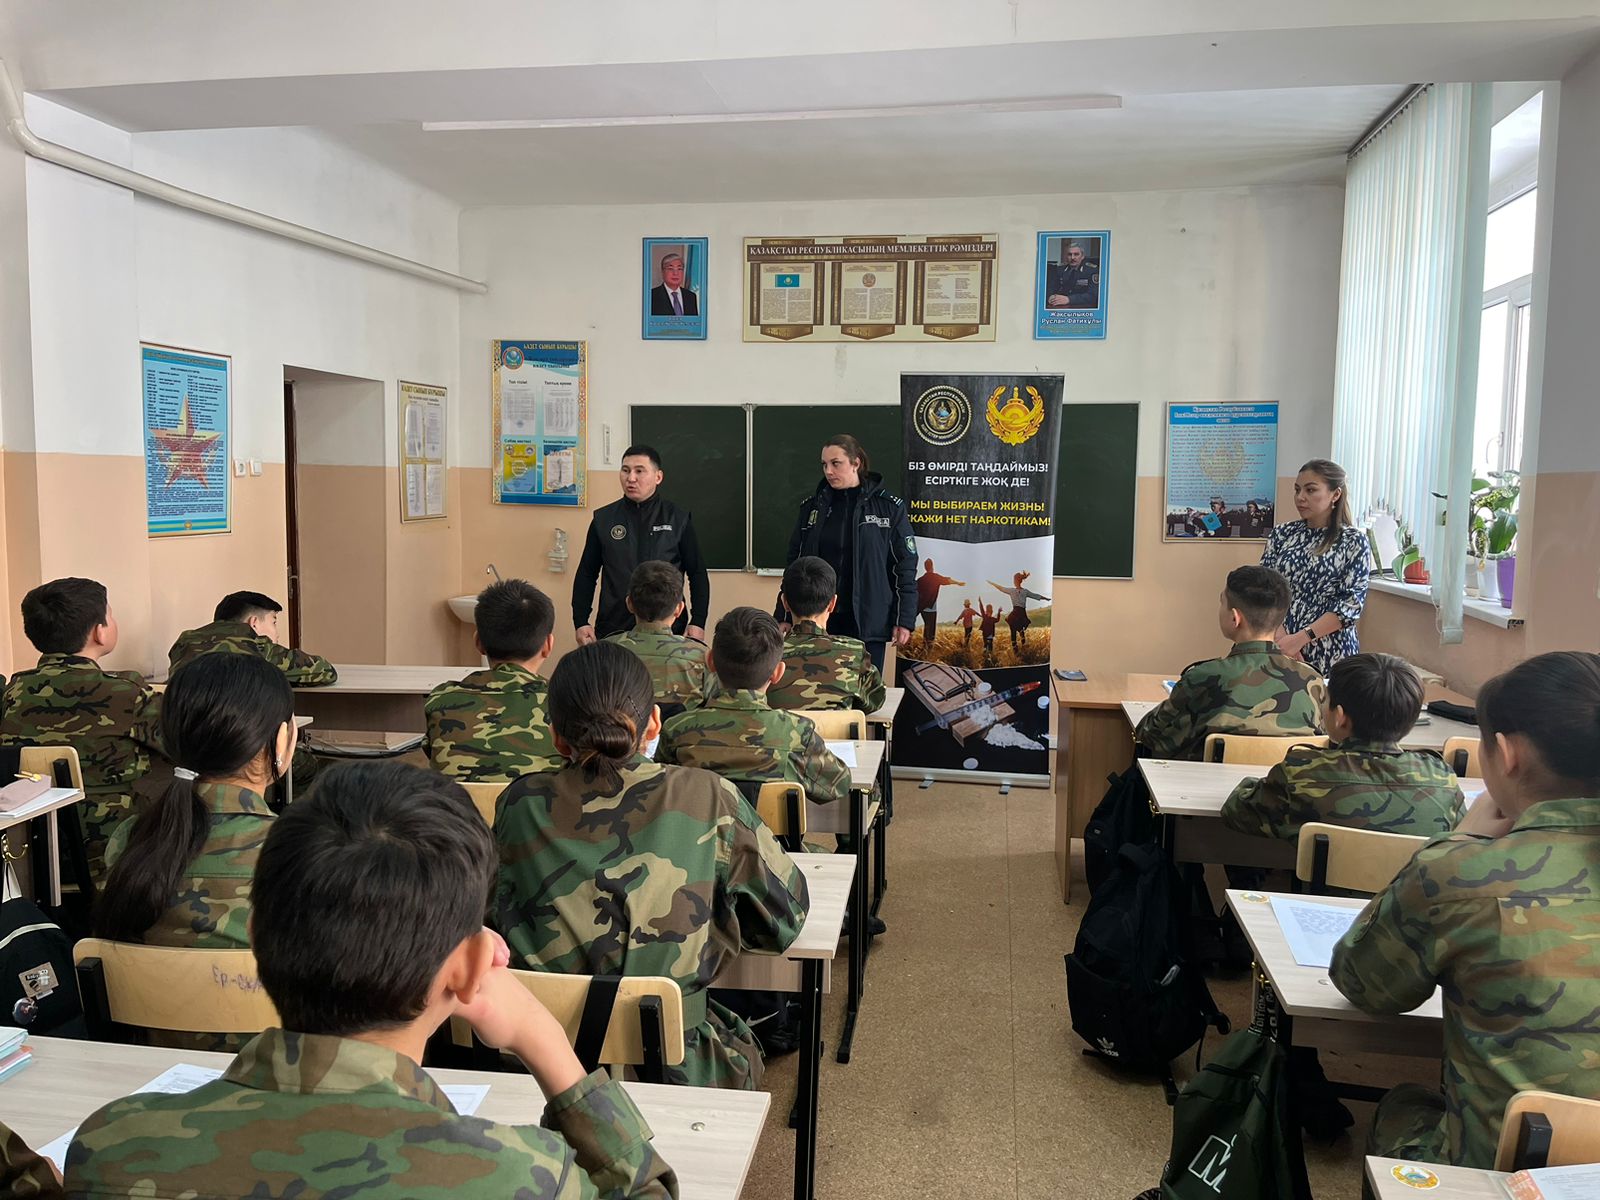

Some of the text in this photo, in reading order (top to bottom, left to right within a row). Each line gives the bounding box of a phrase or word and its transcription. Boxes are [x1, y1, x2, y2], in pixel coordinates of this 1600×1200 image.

[750, 243, 993, 255] ҚАЗАҚСТАН РЕСПУБЛИКАСЫНЫҢ МЕМЛЕКЕТТІК РӘМІЗДЕРІ
[908, 460, 1049, 473] БІЗ ӨМІРДІ ТАҢДАЙМЫЗ!
[925, 476, 1030, 488] ЕСІРТКІГЕ ЖОҚ ДЕ!
[911, 500, 1045, 512] МЫ ВЫБИРАЕМ ЖИЗНЬ!
[907, 514, 1051, 526] КАЖИ НЕТ НАРКОТИКАМ!
